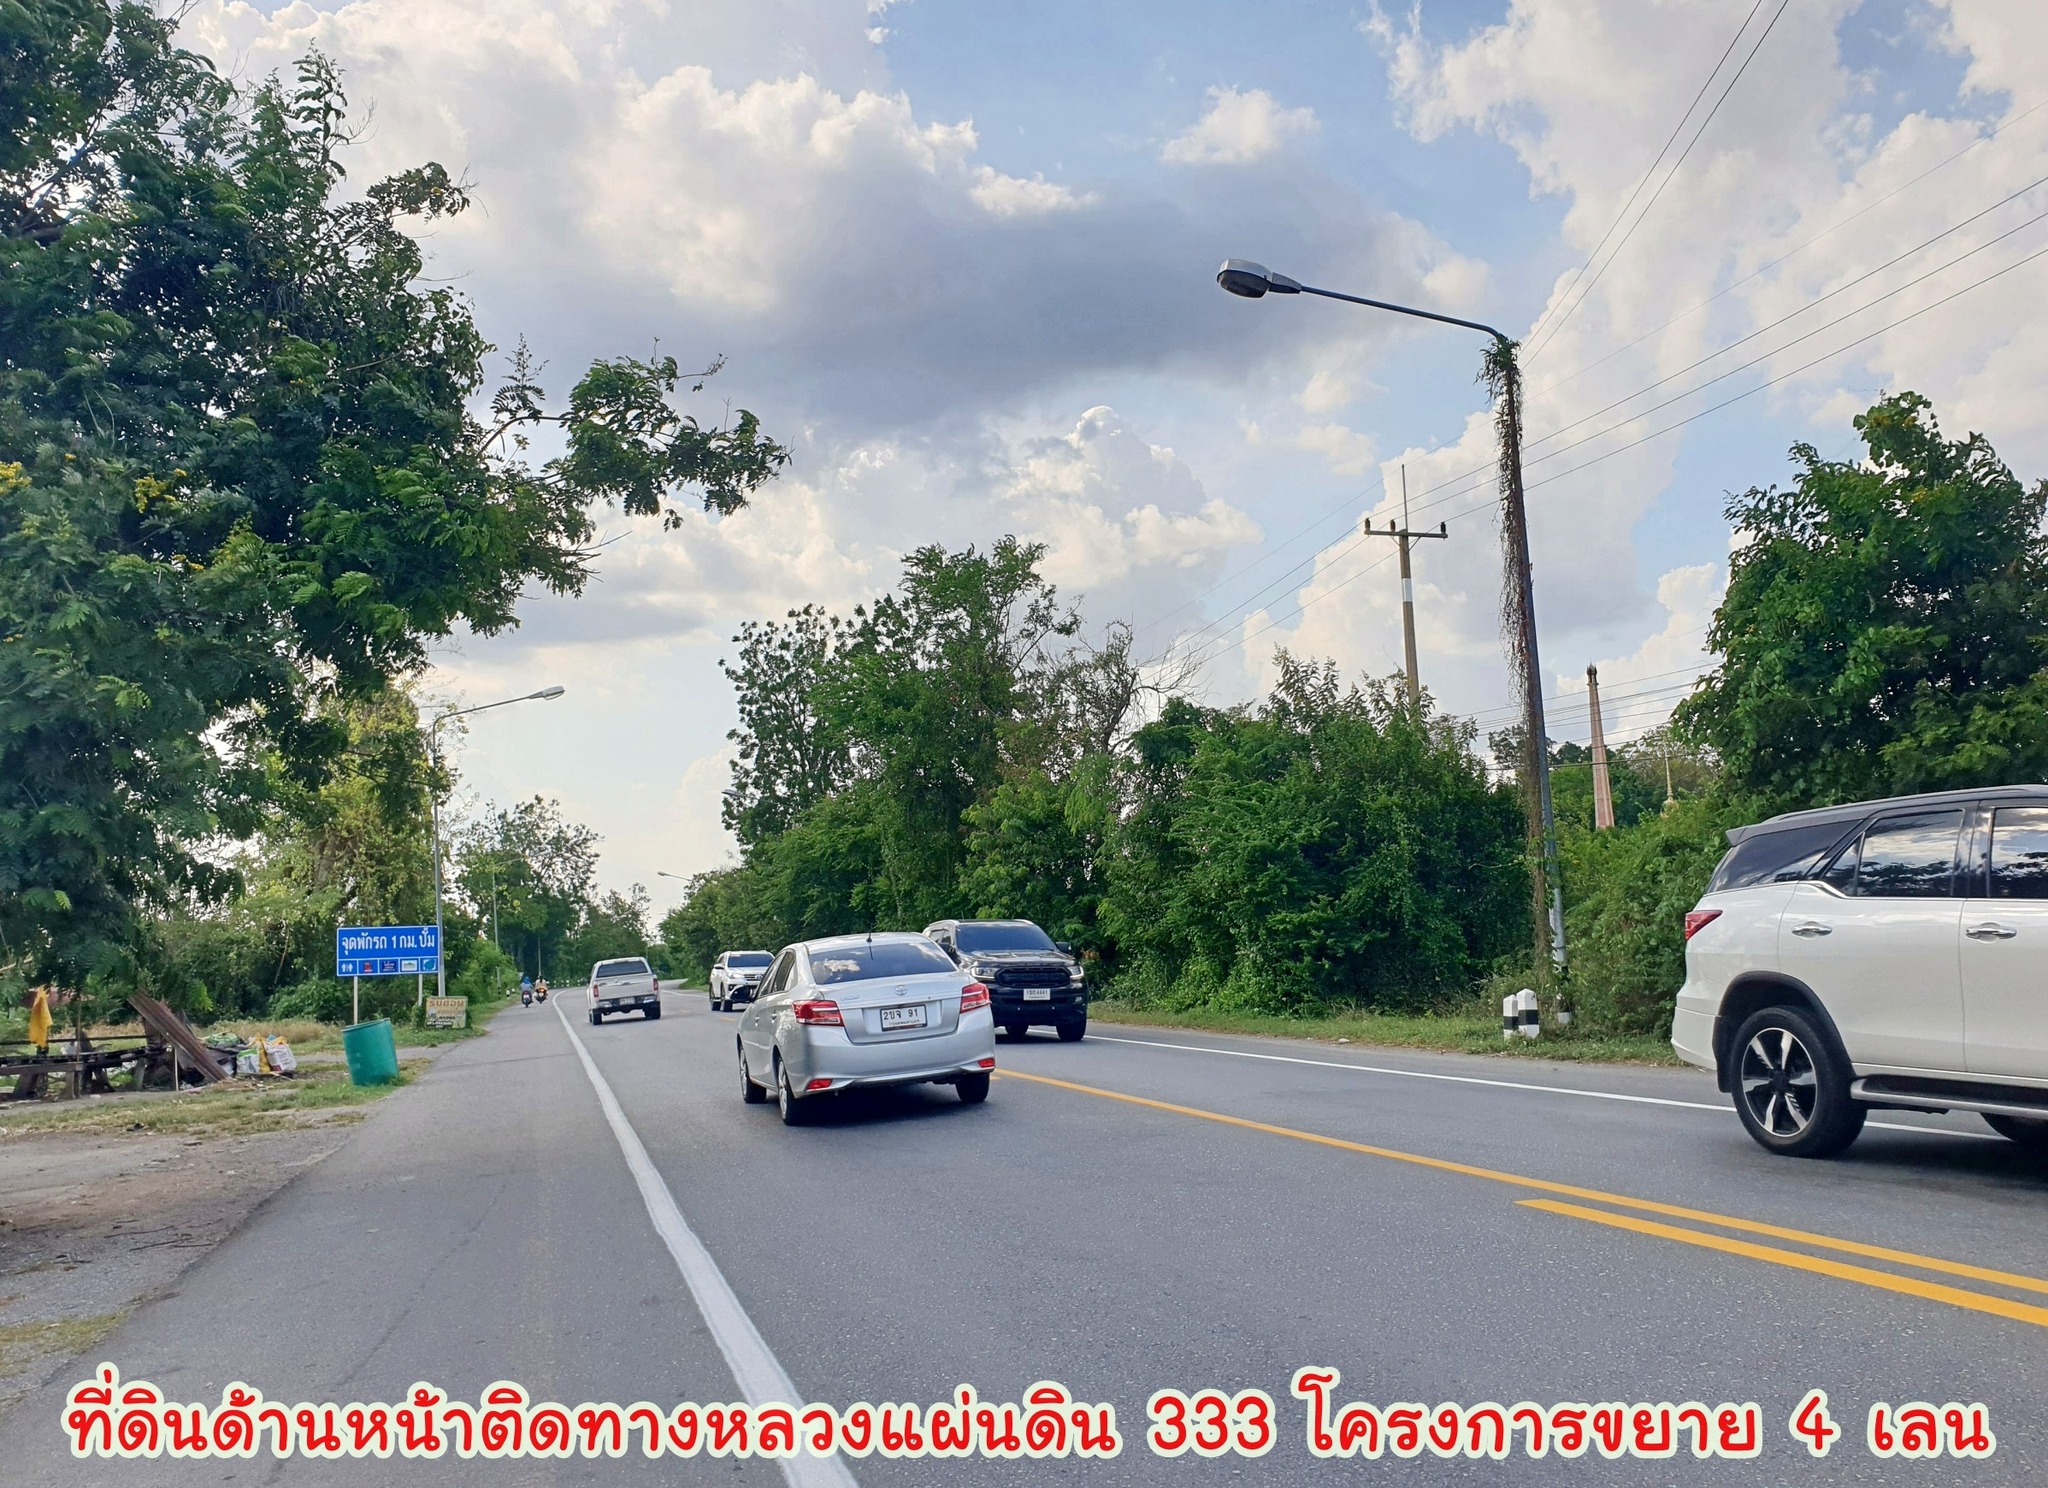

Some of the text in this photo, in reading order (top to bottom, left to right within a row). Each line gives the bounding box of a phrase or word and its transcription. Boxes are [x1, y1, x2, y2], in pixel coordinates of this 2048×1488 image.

[342, 932, 387, 956] จุดพักรถ
[391, 935, 397, 949] 1
[400, 934, 418, 949] กม.
[907, 1008, 918, 1018] 91
